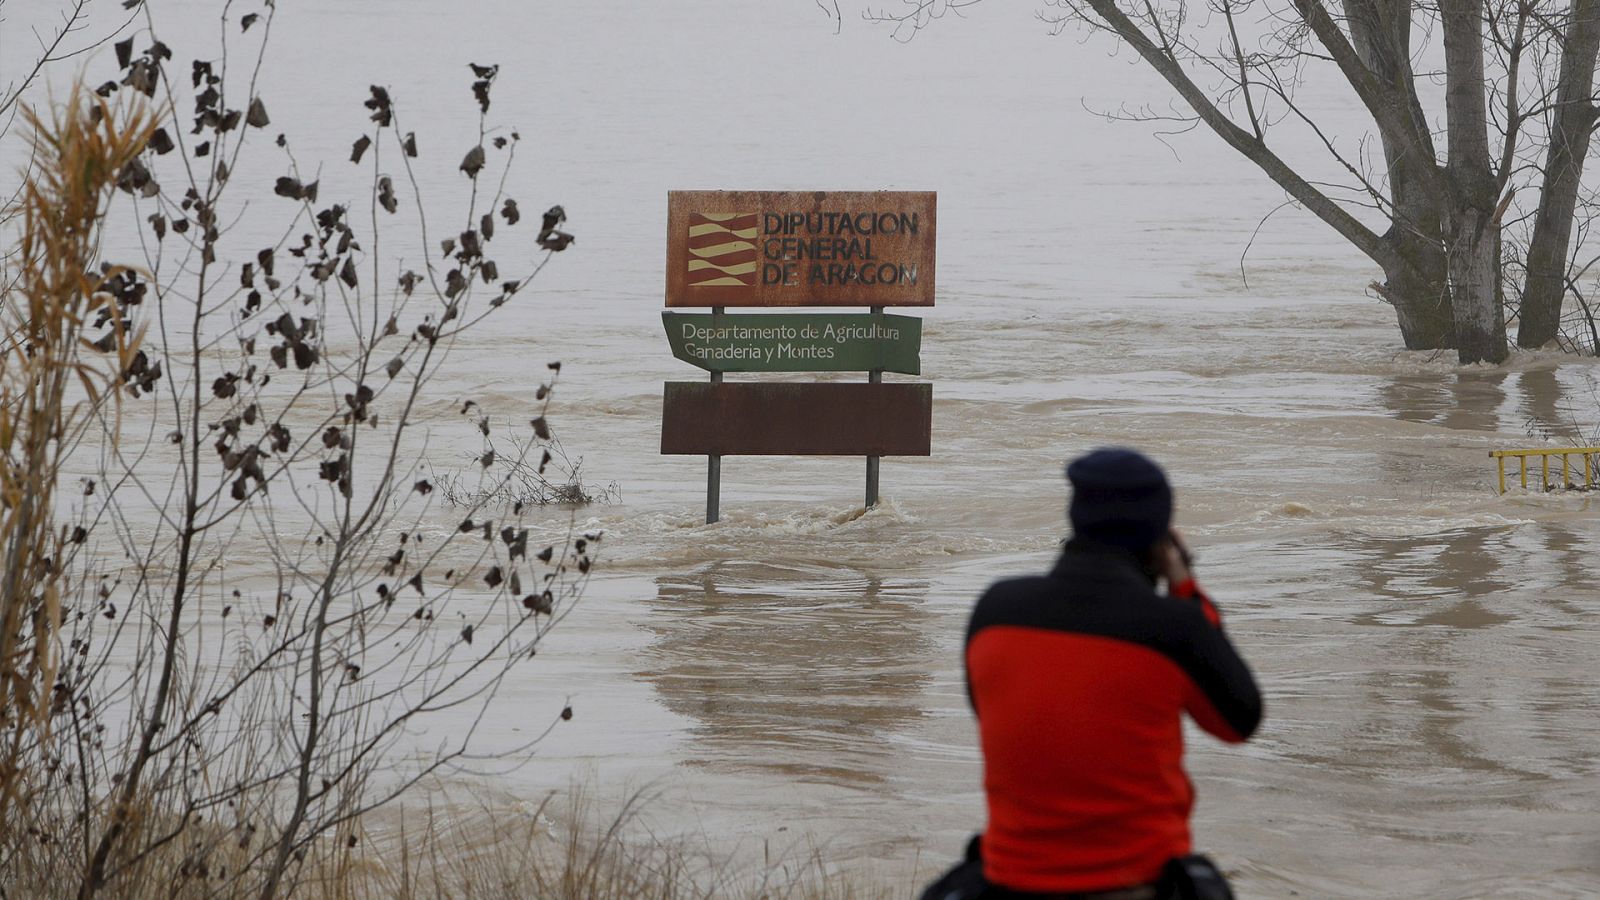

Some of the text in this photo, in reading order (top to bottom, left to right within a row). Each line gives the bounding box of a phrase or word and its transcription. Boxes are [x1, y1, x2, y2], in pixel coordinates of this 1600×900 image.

[764, 211, 919, 235] DIPUTACION
[763, 237, 878, 260] GENERAL
[763, 262, 918, 286] DE ARAGON
[682, 323, 899, 343] Departamento de Agricultura
[764, 347, 774, 363] y
[777, 343, 834, 359] Montes
